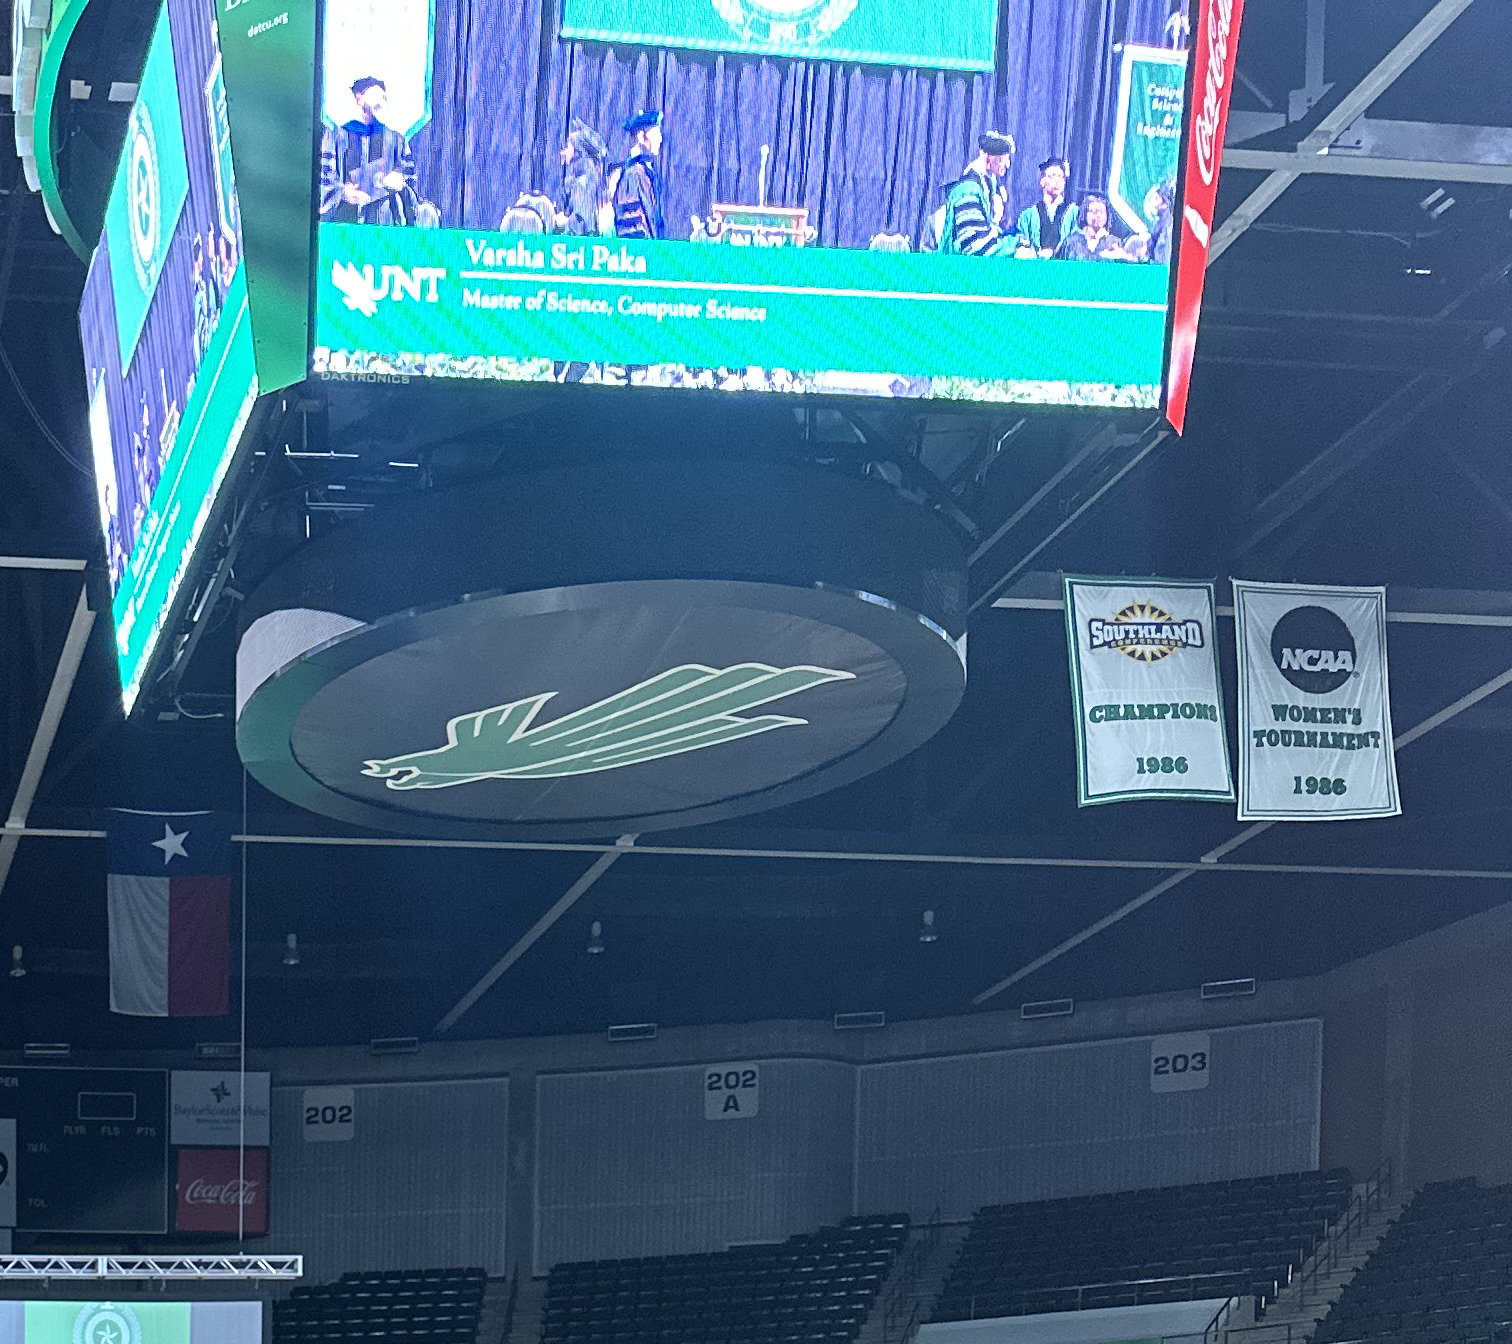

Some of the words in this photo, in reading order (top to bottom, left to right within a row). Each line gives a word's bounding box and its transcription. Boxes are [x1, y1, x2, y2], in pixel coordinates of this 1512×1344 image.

[248, 12, 289, 37] datcu.org
[465, 238, 545, 268] Varsha
[551, 243, 585, 271] Sri
[592, 245, 646, 273] Paka
[362, 263, 446, 302] UNT
[463, 288, 523, 310] Master
[525, 290, 546, 311] of
[546, 292, 612, 316] Science,
[617, 295, 702, 322] Computer
[706, 298, 767, 322] Science
[320, 371, 410, 385] DAKTRONICS
[1090, 620, 1203, 647] SOUTHLAND
[1280, 648, 1354, 673] NCAA
[1088, 702, 1218, 724] CHAMPIONS
[1271, 703, 1363, 726] WOMEN'S
[1253, 729, 1381, 751] TOURNAMENT
[1136, 755, 1189, 775] 1986
[1292, 775, 1347, 796] 1986
[1153, 1051, 1209, 1077] 203
[706, 1068, 758, 1093] 202
[305, 1105, 353, 1126] 202
[721, 1093, 742, 1114] A
[63, 1125, 87, 1136] PLYR
[136, 1126, 157, 1138] PTS
[185, 1179, 260, 1205] Coca-Cola
